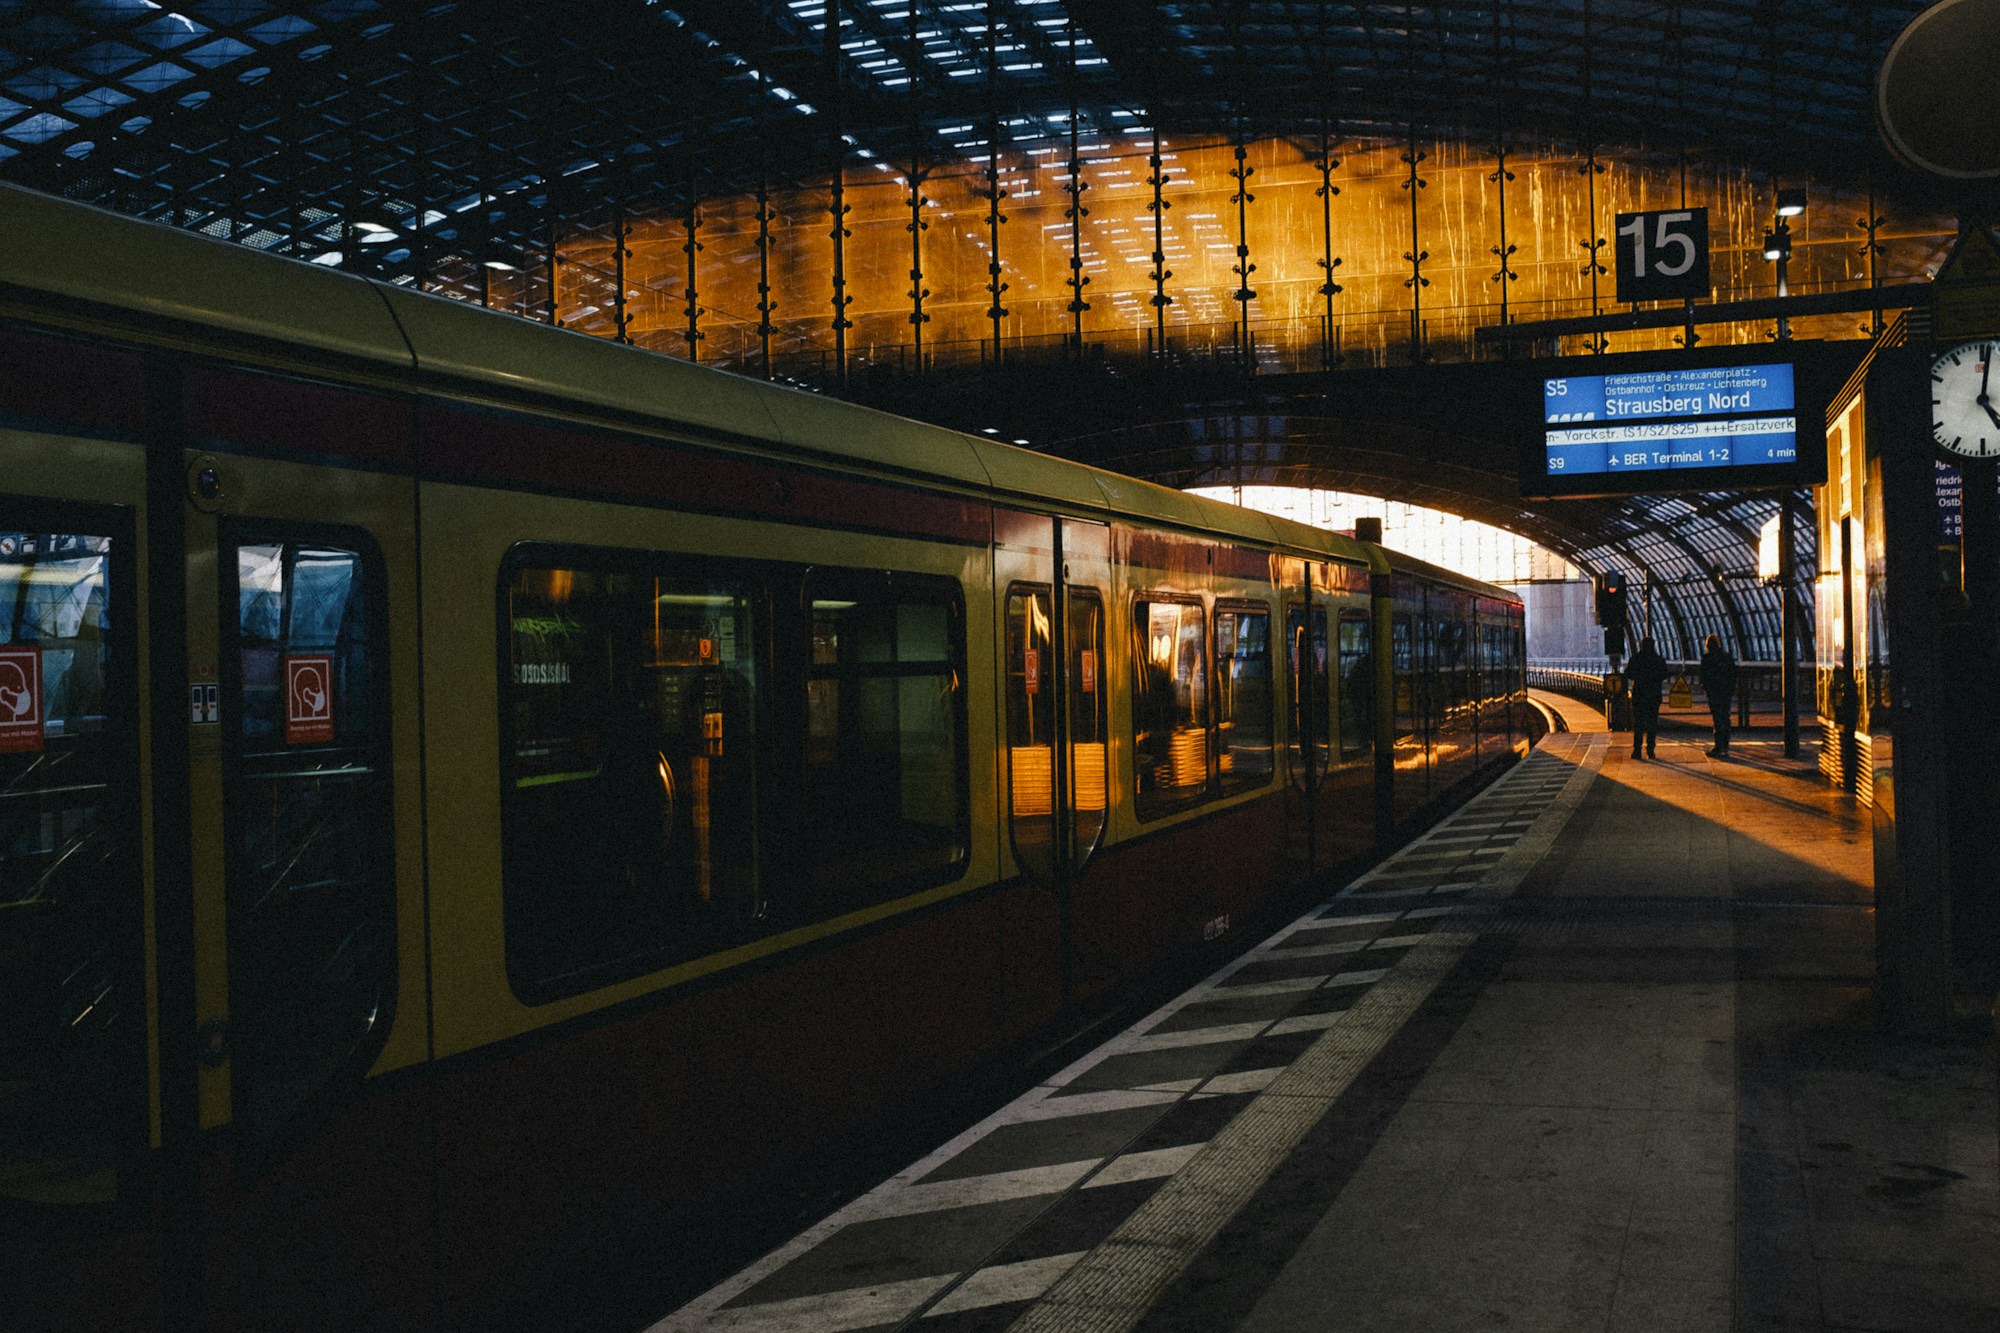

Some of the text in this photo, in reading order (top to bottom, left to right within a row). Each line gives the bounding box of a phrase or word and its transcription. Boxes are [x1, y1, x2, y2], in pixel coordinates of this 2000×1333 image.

[1619, 212, 1696, 277] 15
[1604, 373, 1672, 385] Friedrichstraße
[1680, 368, 1751, 381] Alexanderplatz
[1546, 379, 1568, 397] S5
[1605, 384, 1655, 396] Ostbahnhof
[1663, 381, 1705, 392] Ostkreuz
[1713, 377, 1767, 389] Lichtenberg
[1605, 390, 1751, 416] Strausberg Nord
[1565, 428, 1619, 441] Yorckstr.
[1623, 424, 1699, 438] (S1/S2/S25)
[1549, 447, 1796, 469] S9 BER Terminal 1-2 4 min
